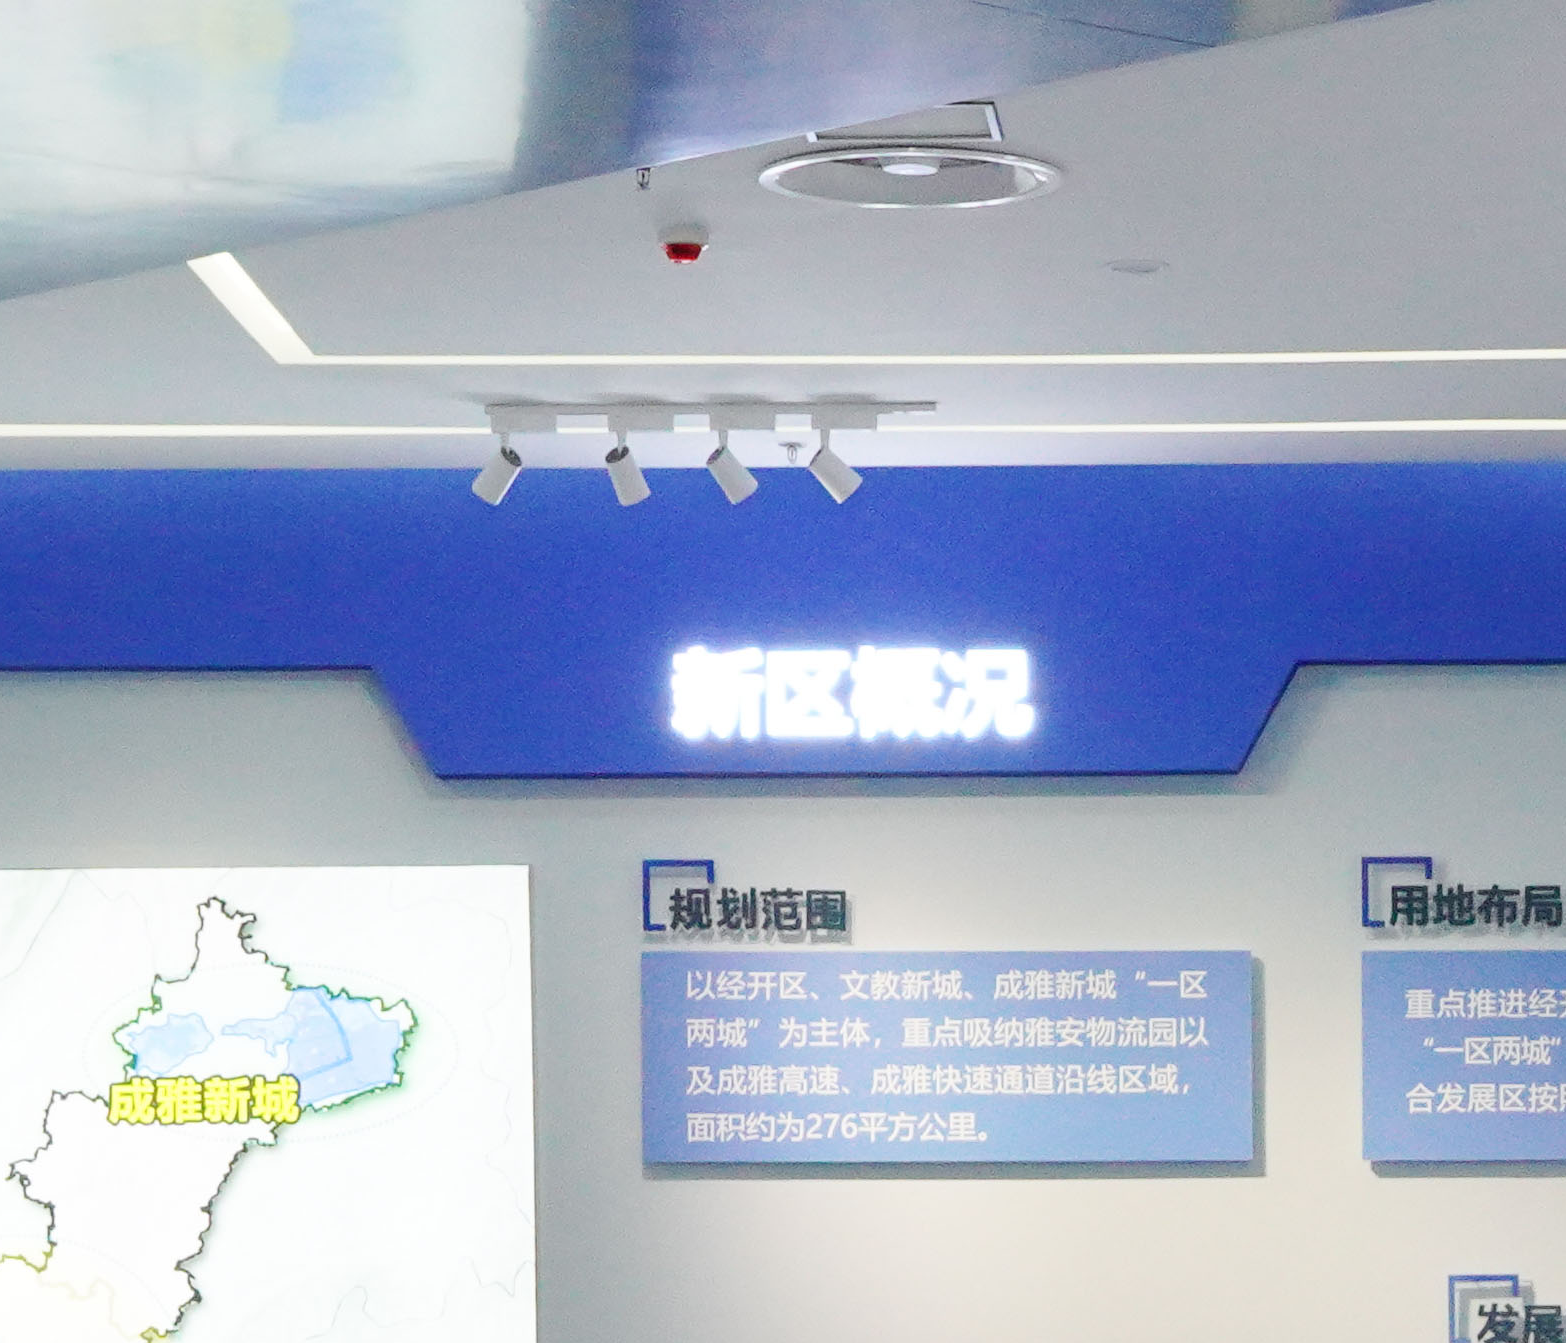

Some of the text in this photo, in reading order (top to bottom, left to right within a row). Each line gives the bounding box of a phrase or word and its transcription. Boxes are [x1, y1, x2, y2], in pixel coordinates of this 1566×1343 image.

[669, 888, 848, 931] 规划范围
[1390, 885, 1562, 928] 用地布局
[107, 1075, 301, 1125] 成雅新城
[686, 1065, 1190, 1097] 及成雅高速、成雅快速通道沿线区域，
[686, 1112, 988, 1144] 面积约为276平方公里。
